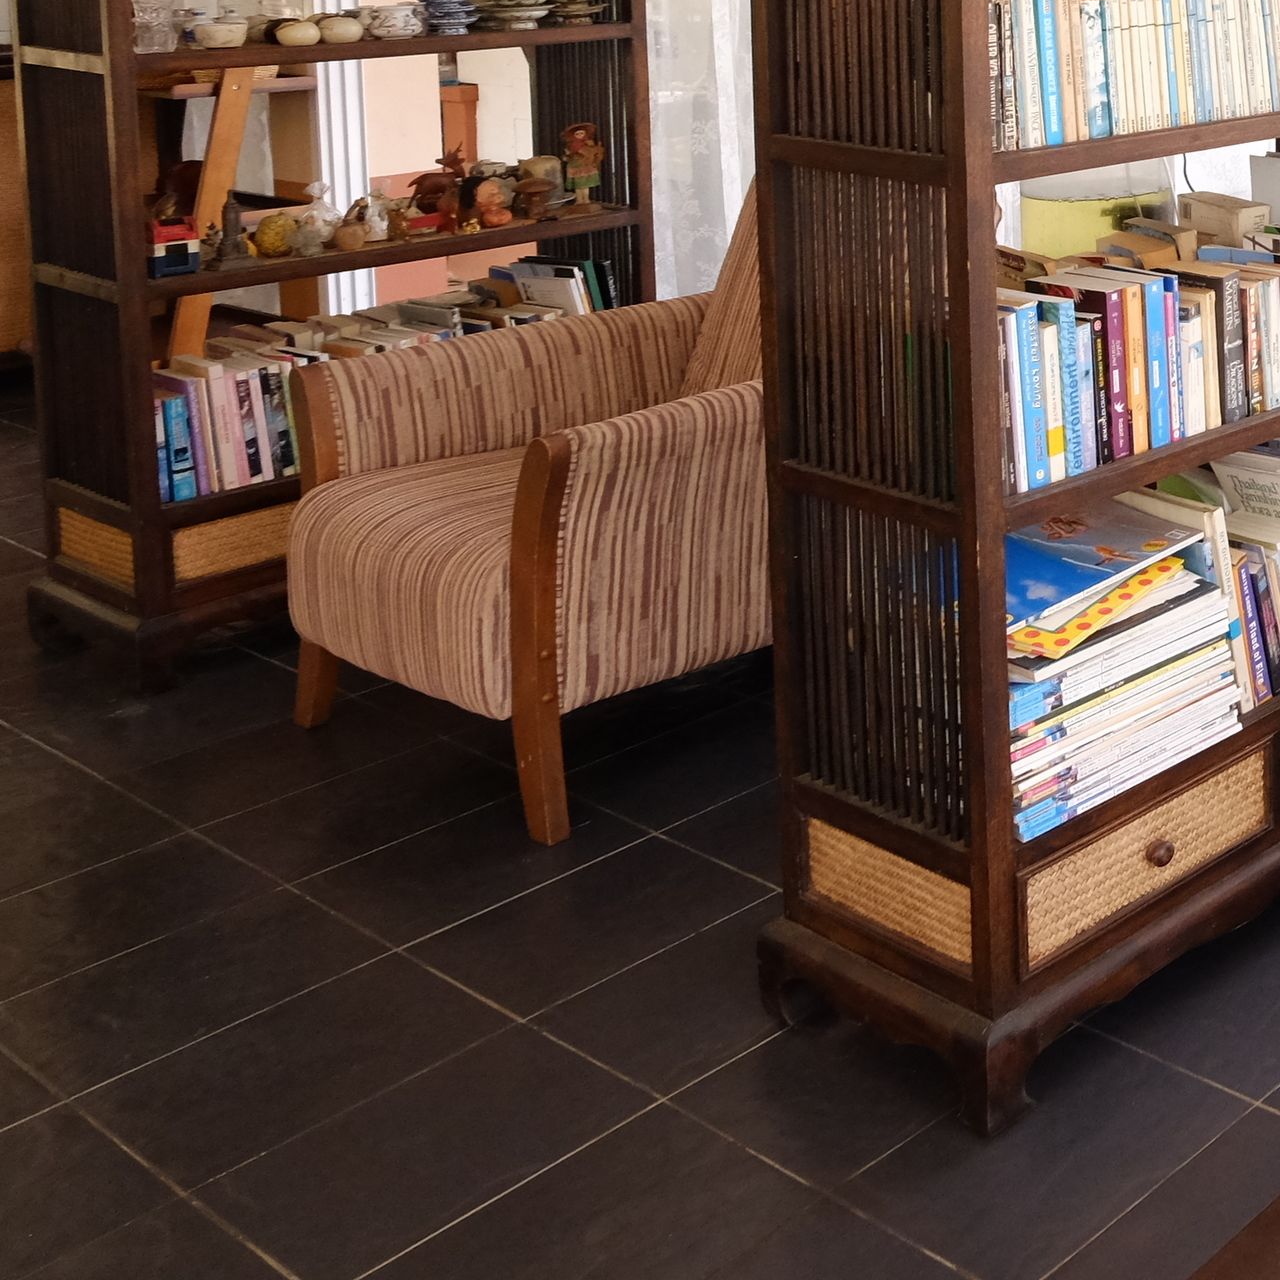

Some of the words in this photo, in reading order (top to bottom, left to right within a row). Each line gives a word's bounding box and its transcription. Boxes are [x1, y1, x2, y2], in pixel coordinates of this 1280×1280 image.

[1043, 18, 1054, 47] DEAN
[1045, 50, 1056, 92] KOONTZ
[1225, 280, 1233, 331] MARTIN
[1062, 313, 1076, 355] words
[1229, 361, 1237, 409] DRAGONS
[1065, 361, 1083, 470] environment
[1241, 500, 1272, 516] Flora
[1247, 621, 1260, 650] Flood
[1252, 651, 1261, 662] of
[1254, 664, 1266, 686] Fire
